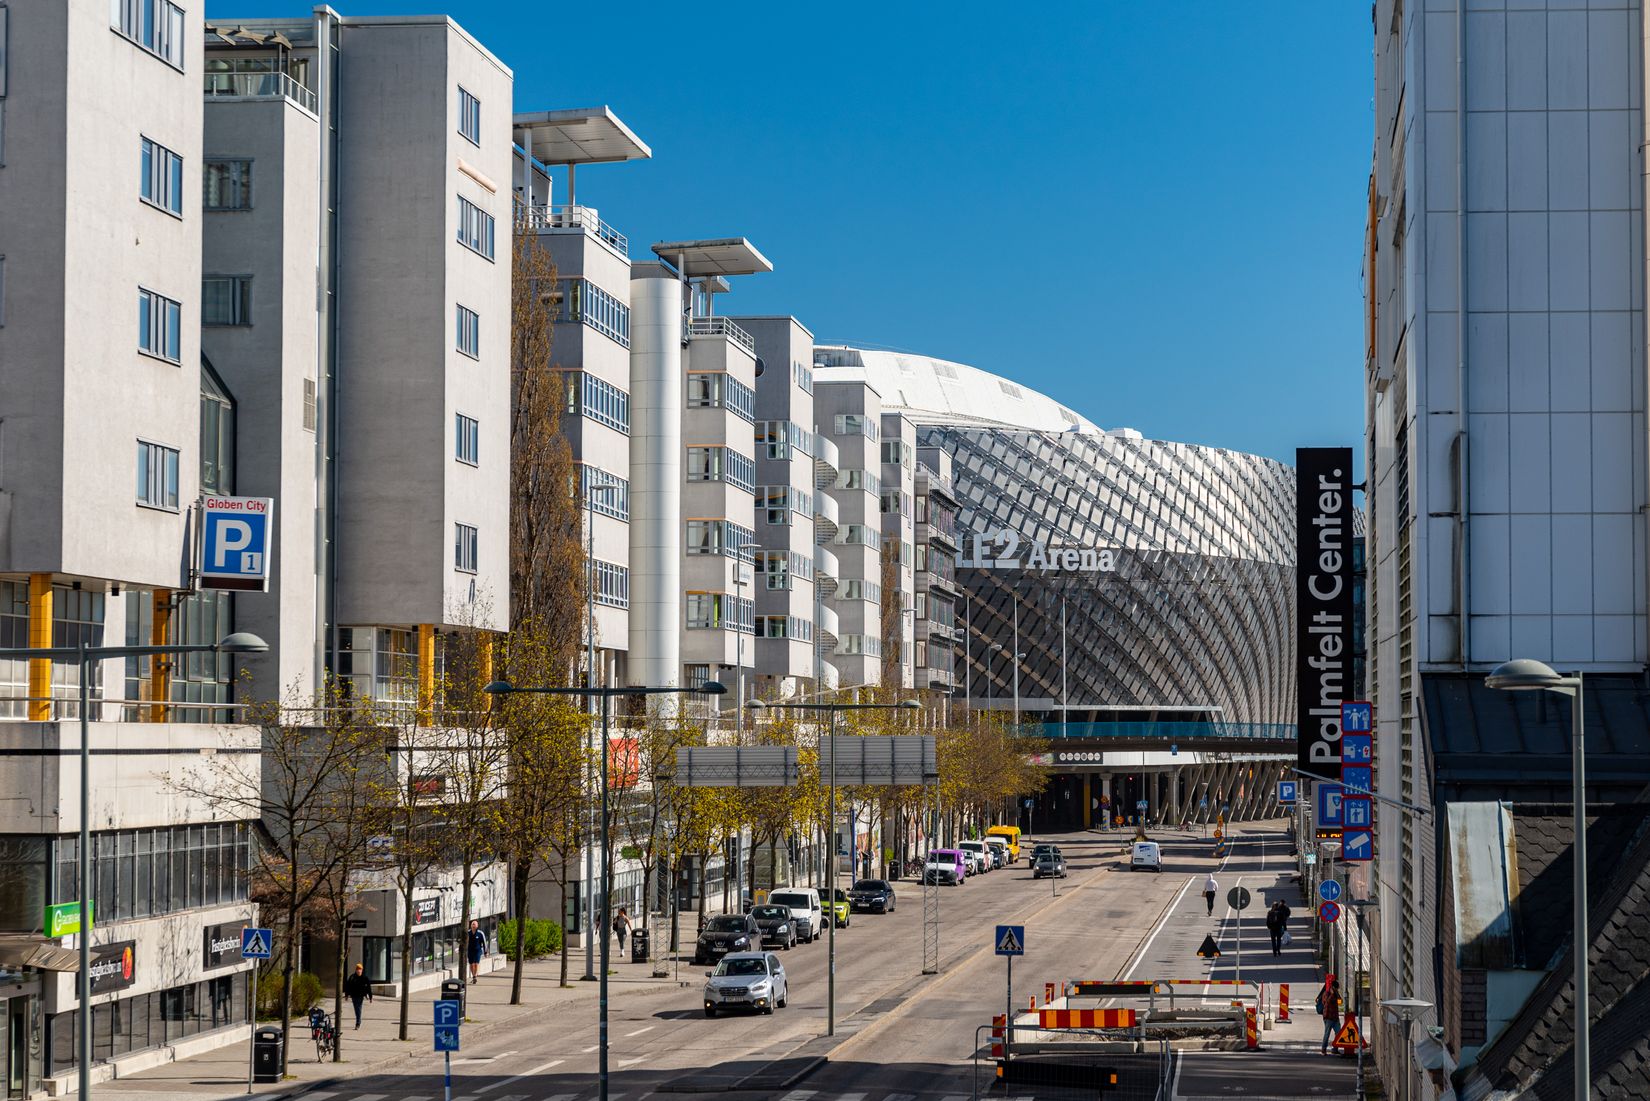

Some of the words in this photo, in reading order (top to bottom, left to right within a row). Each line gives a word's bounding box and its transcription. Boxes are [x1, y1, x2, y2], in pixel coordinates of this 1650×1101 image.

[207, 498, 243, 510] Globen
[246, 500, 267, 513] City
[214, 519, 252, 567] P
[1308, 468, 1343, 601] Center.
[247, 554, 255, 571] 1
[1026, 540, 1116, 572] Arena
[1308, 611, 1343, 763] Palmfelt
[1283, 785, 1293, 797] P
[441, 1008, 453, 1024] P
